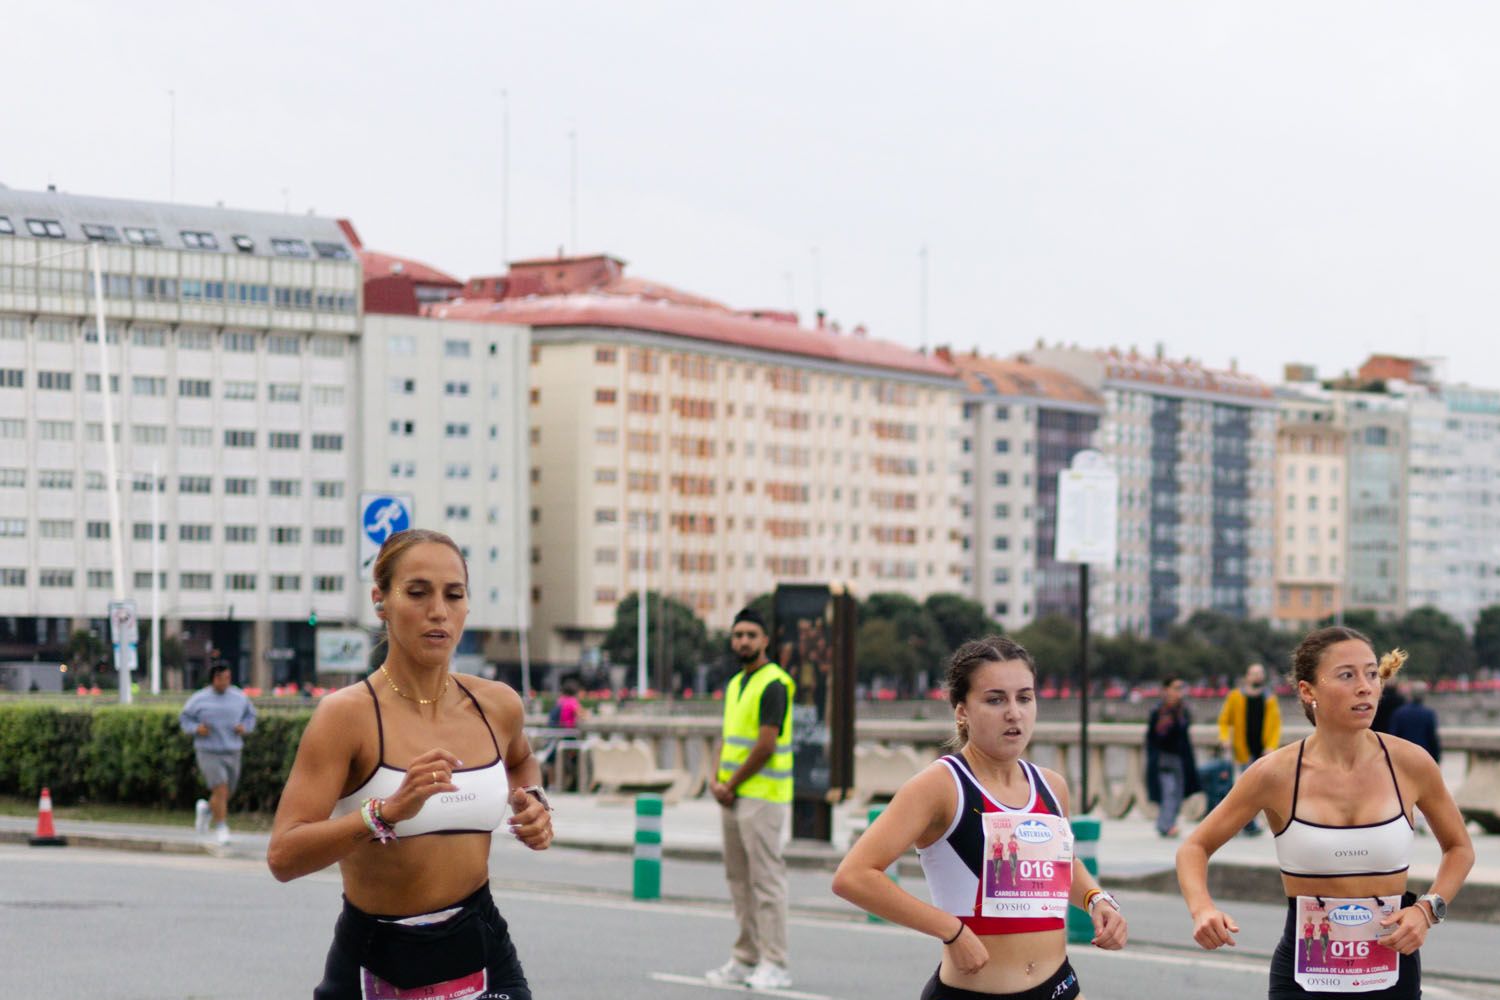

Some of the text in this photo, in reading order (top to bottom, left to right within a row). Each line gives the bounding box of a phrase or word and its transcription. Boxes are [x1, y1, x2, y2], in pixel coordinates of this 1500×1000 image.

[440, 793, 476, 803] OYSHO
[1334, 849, 1369, 857] OYSHO
[1019, 861, 1054, 878] 016
[996, 903, 1031, 911] OYSHO
[1331, 912, 1371, 921] ASTURIANA
[1330, 941, 1370, 957] 016
[1307, 977, 1341, 986] OYSHO
